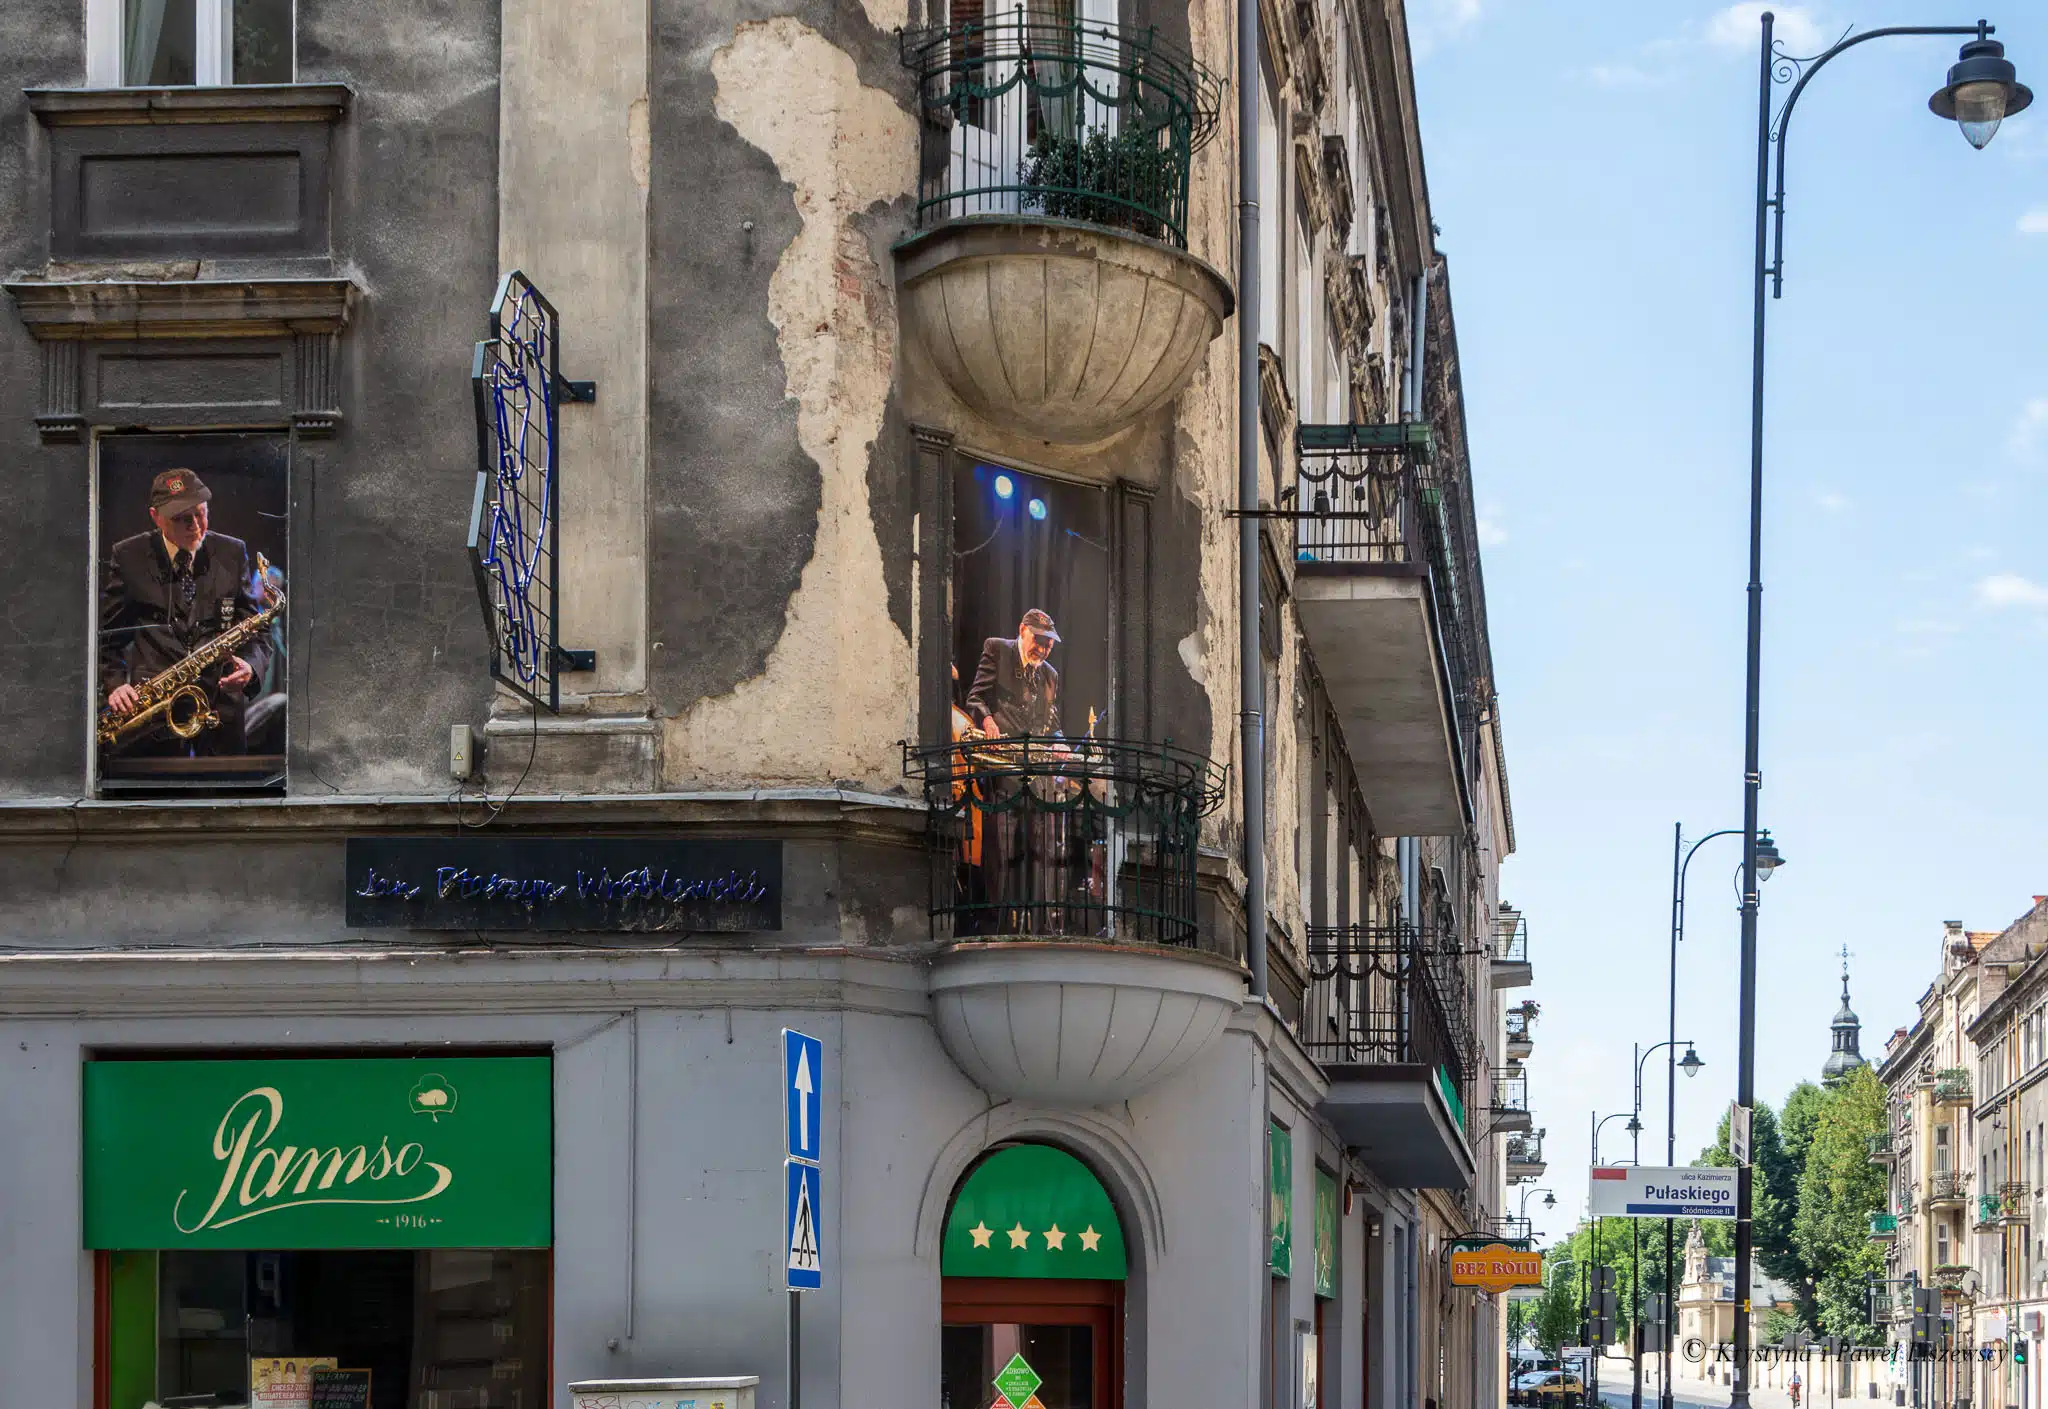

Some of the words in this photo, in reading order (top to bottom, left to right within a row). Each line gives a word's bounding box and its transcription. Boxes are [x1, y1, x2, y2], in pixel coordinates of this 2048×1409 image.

[357, 867, 420, 902] Jan
[174, 1087, 453, 1234] Pamso
[1681, 1172, 1696, 1181] ulica
[1697, 1173, 1732, 1181] Kazimierza
[1645, 1185, 1730, 1203] Pułaskiego
[1681, 1206, 1724, 1215] Śródmieście
[394, 1213, 427, 1229] 1916
[1455, 1261, 1487, 1276] BEZ
[1491, 1260, 1538, 1276] BÓLU
